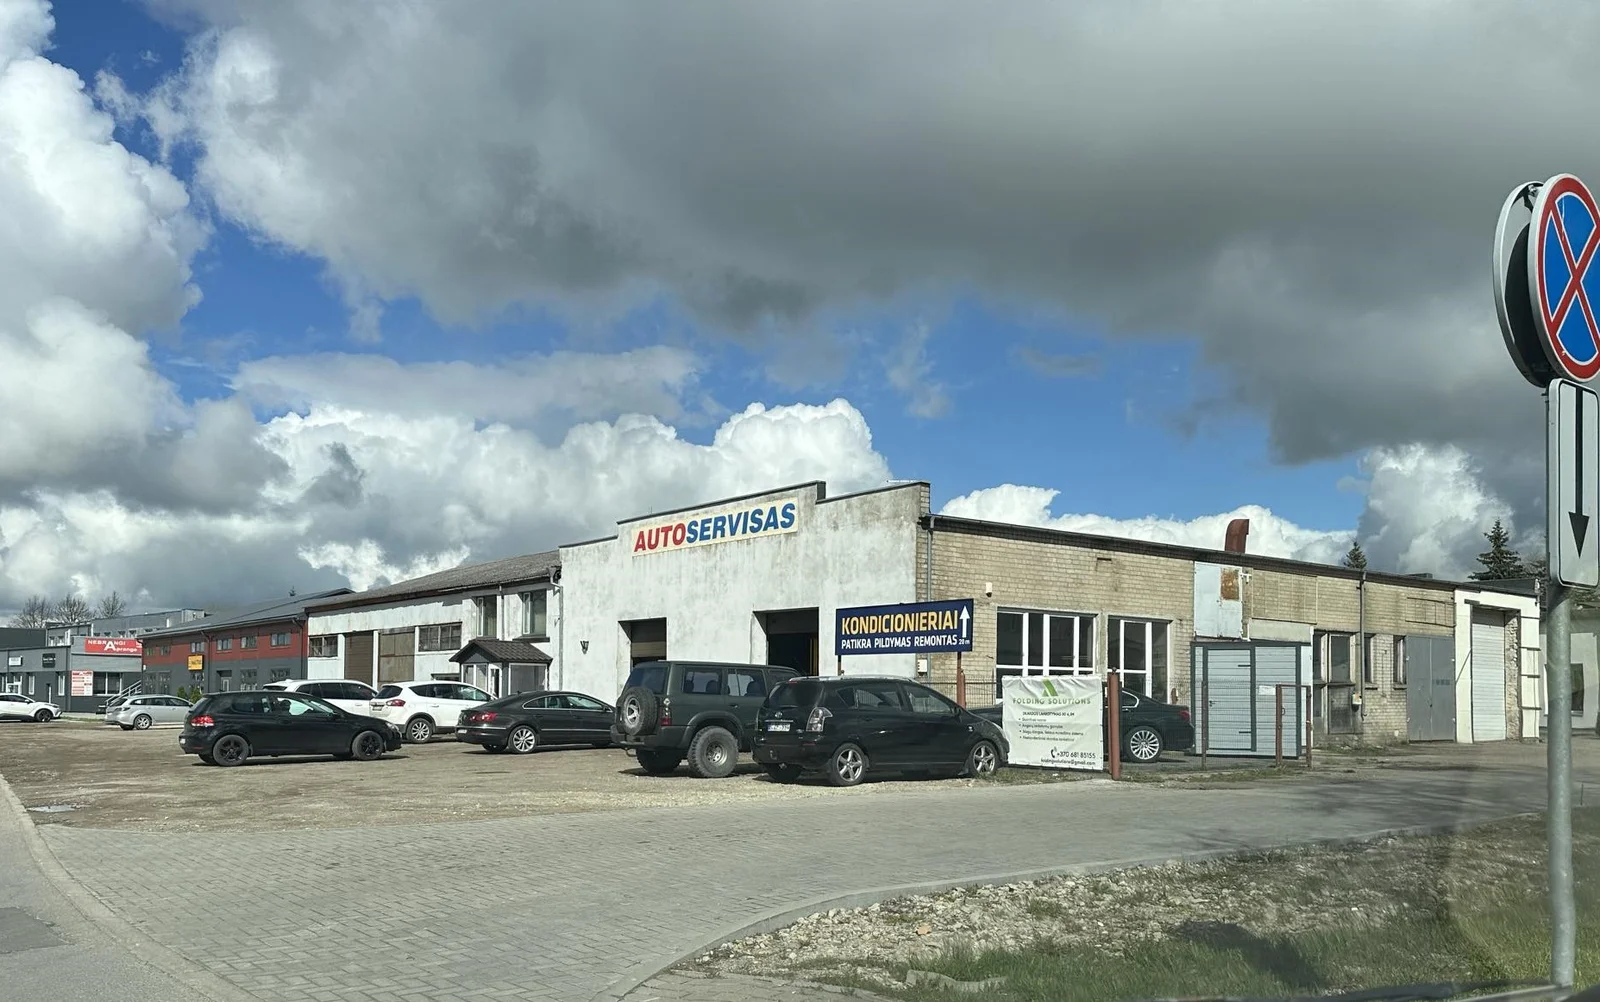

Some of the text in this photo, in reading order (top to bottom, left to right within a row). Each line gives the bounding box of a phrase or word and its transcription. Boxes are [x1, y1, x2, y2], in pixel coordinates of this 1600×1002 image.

[634, 503, 795, 552] AUTOSERVISAS
[841, 610, 958, 635] KONDICIONIERIAI
[841, 634, 958, 649] PATIKRA PILDYMAS REMONTAS
[1012, 697, 1091, 705] FOLDING SOLUTIONS
